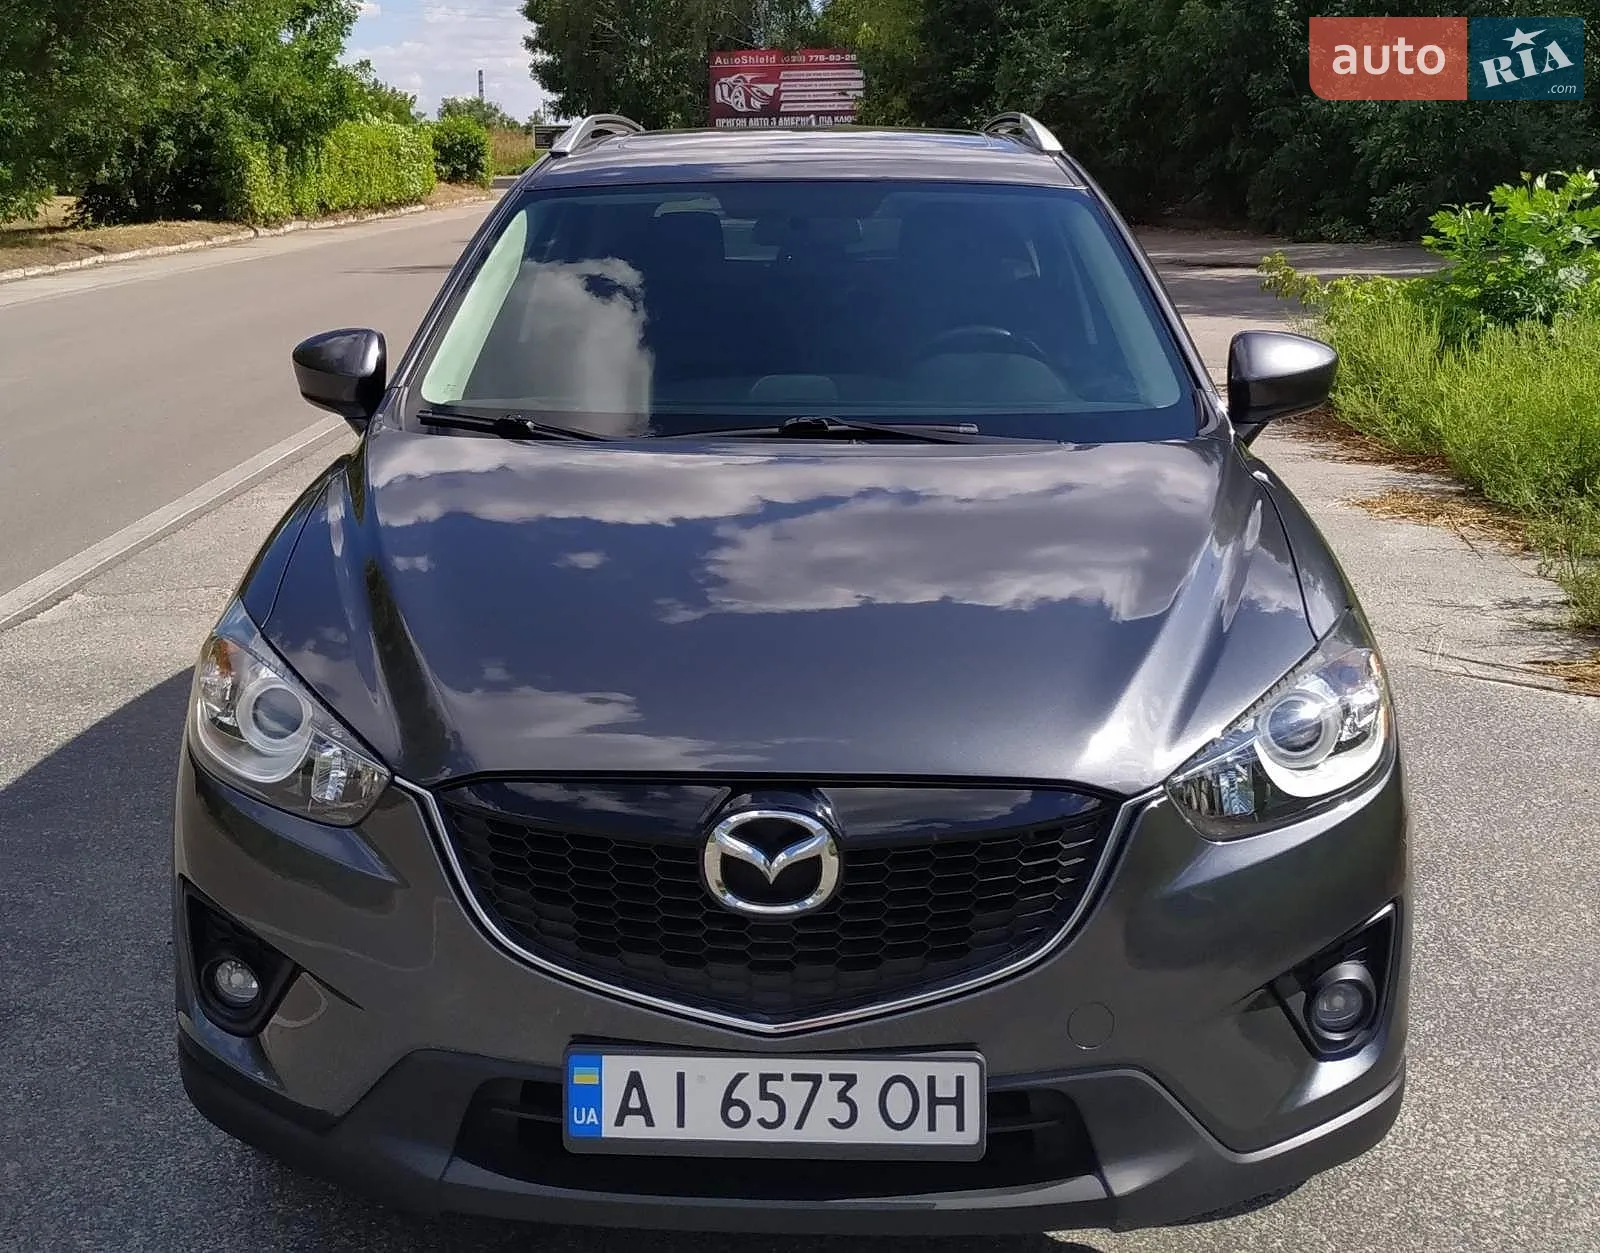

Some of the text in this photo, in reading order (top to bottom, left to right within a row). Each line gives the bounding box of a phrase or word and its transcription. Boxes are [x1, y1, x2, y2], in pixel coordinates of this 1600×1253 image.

[714, 55, 776, 65] AutoShield
[715, 118, 747, 129] ПРИГОН
[748, 117, 769, 128] АВТО
[778, 115, 817, 128] АМЕРИК
[613, 1070, 966, 1132] AI 6573 OH
[573, 1107, 599, 1125] UA
